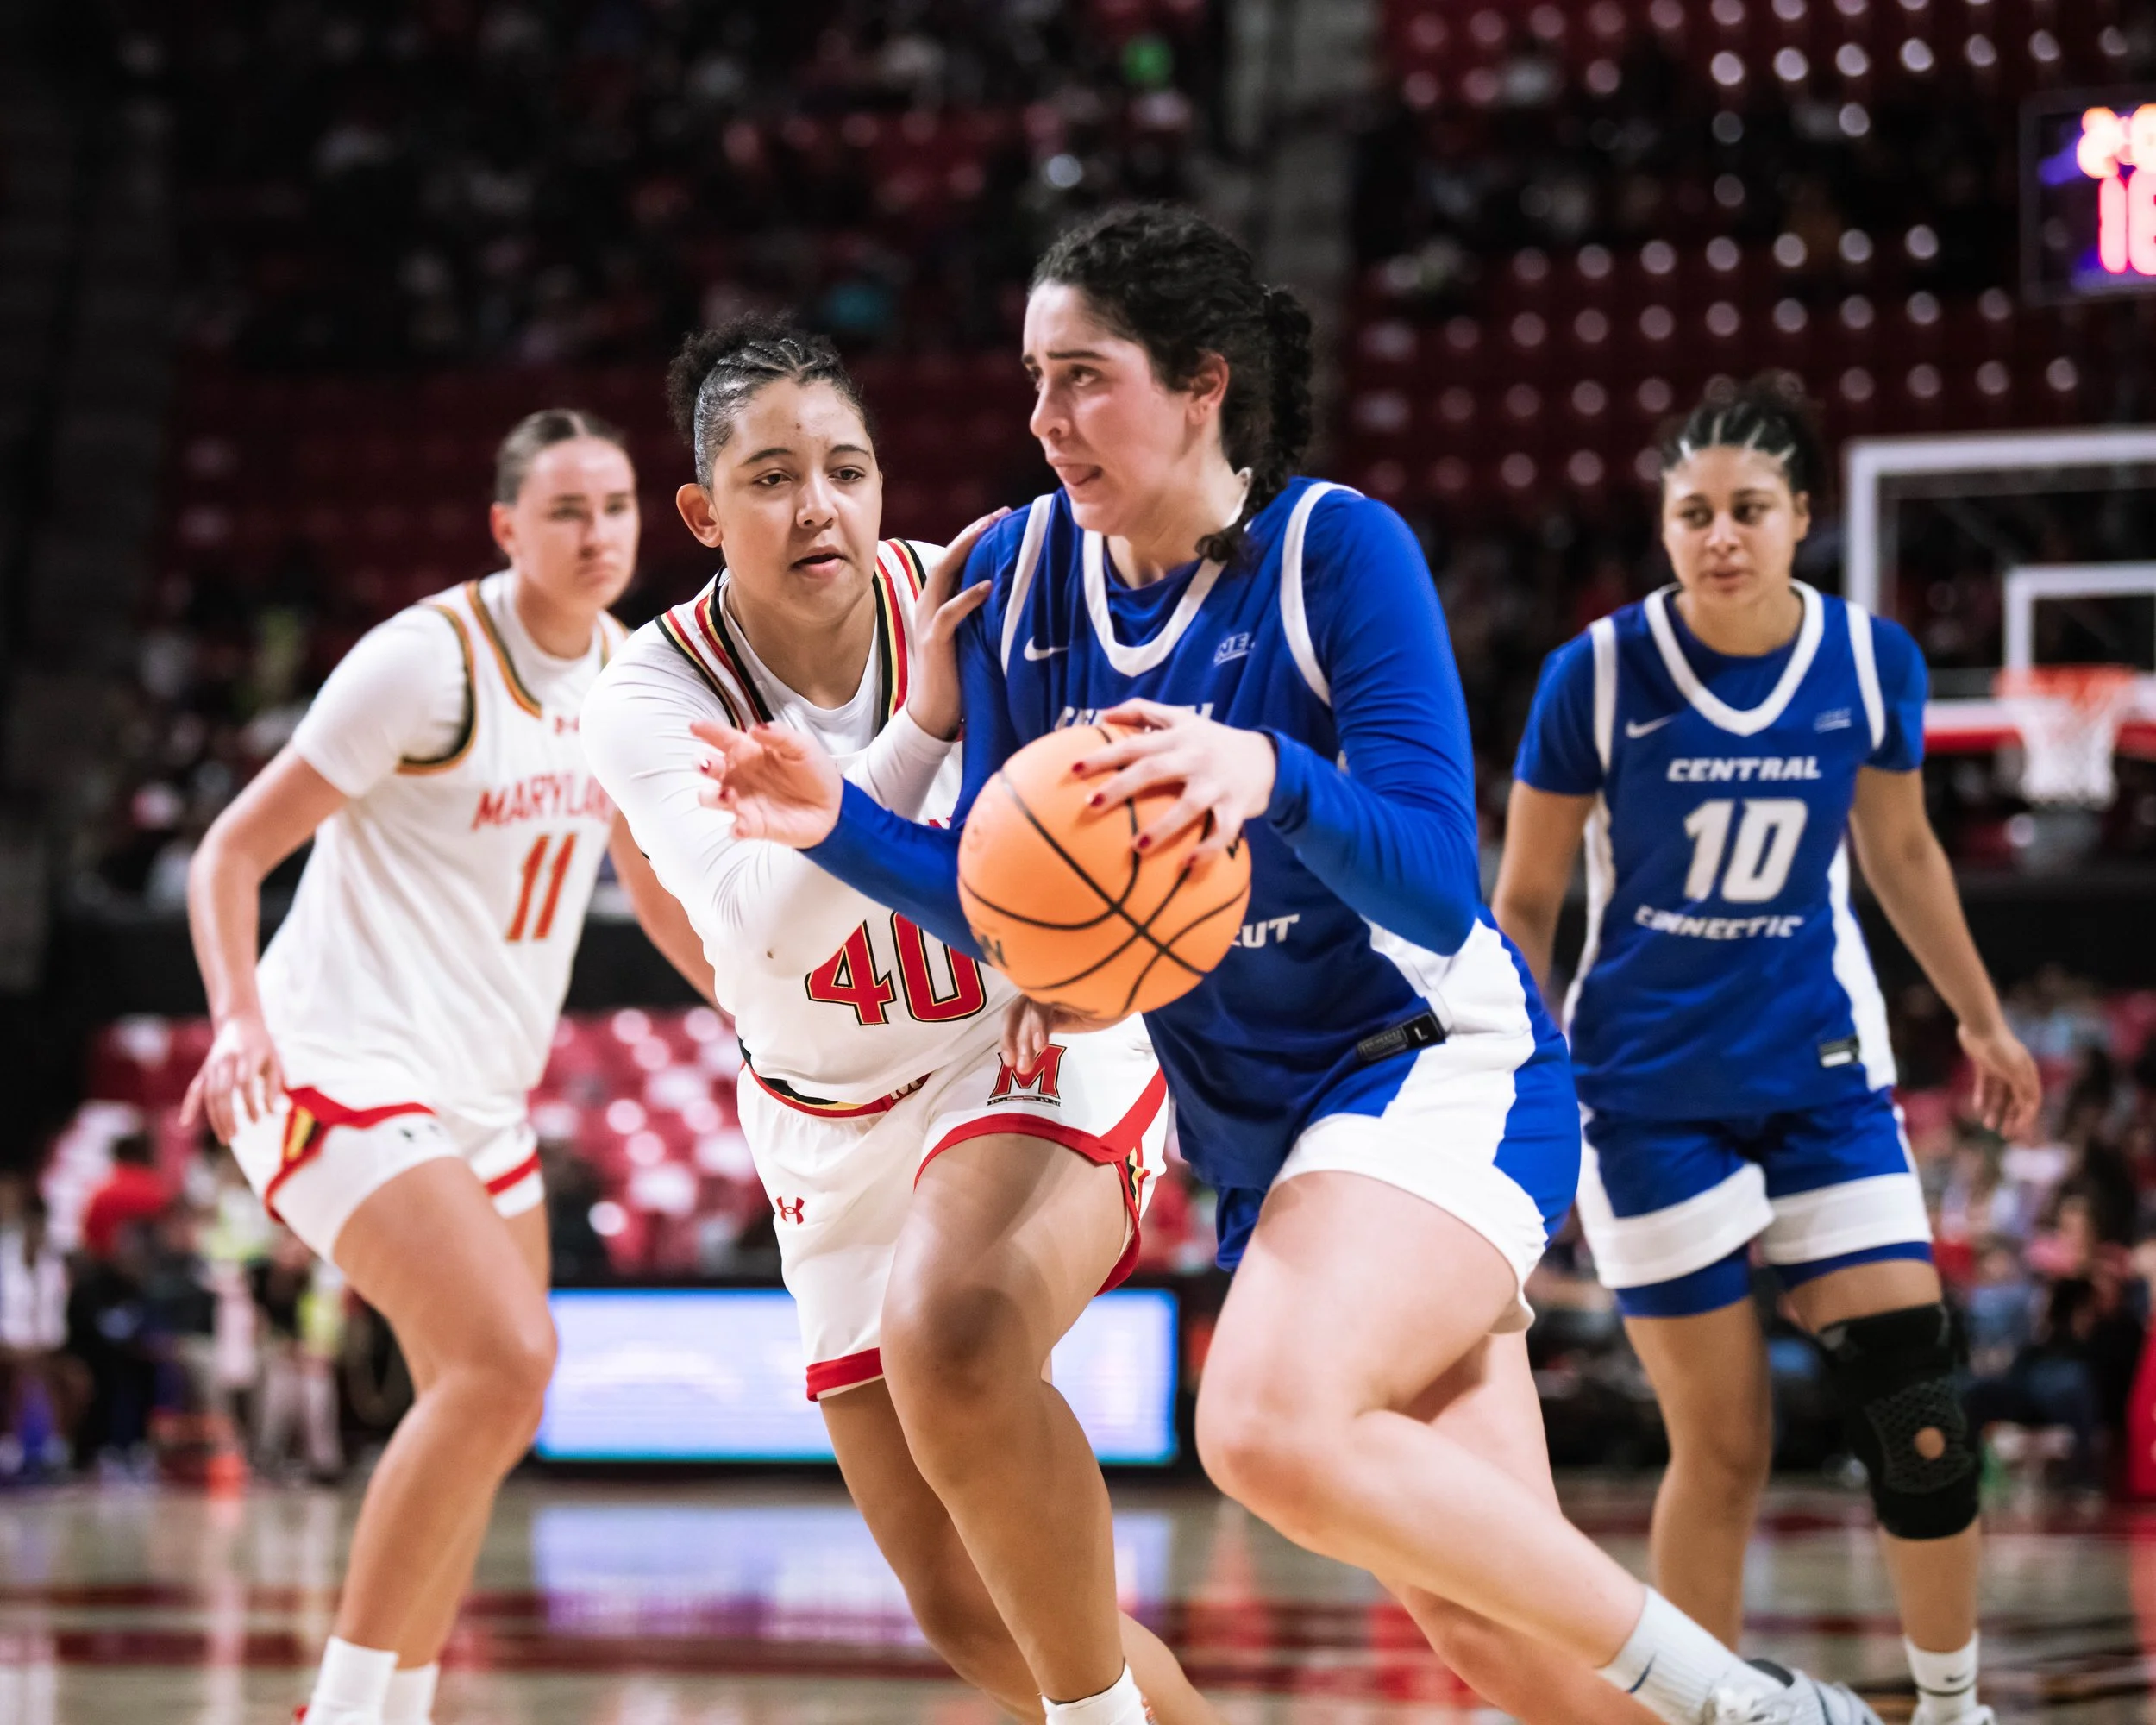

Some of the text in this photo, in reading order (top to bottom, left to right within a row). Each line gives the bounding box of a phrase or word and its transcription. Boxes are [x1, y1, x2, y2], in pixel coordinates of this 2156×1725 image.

[1213, 631, 1255, 667] NE
[1666, 756, 1821, 782] CENTRAL
[1684, 798, 1808, 902] 10
[505, 833, 578, 942] 11
[805, 910, 987, 1026] 40
[1413, 1026, 1429, 1041] L
[988, 1043, 1068, 1100] M
